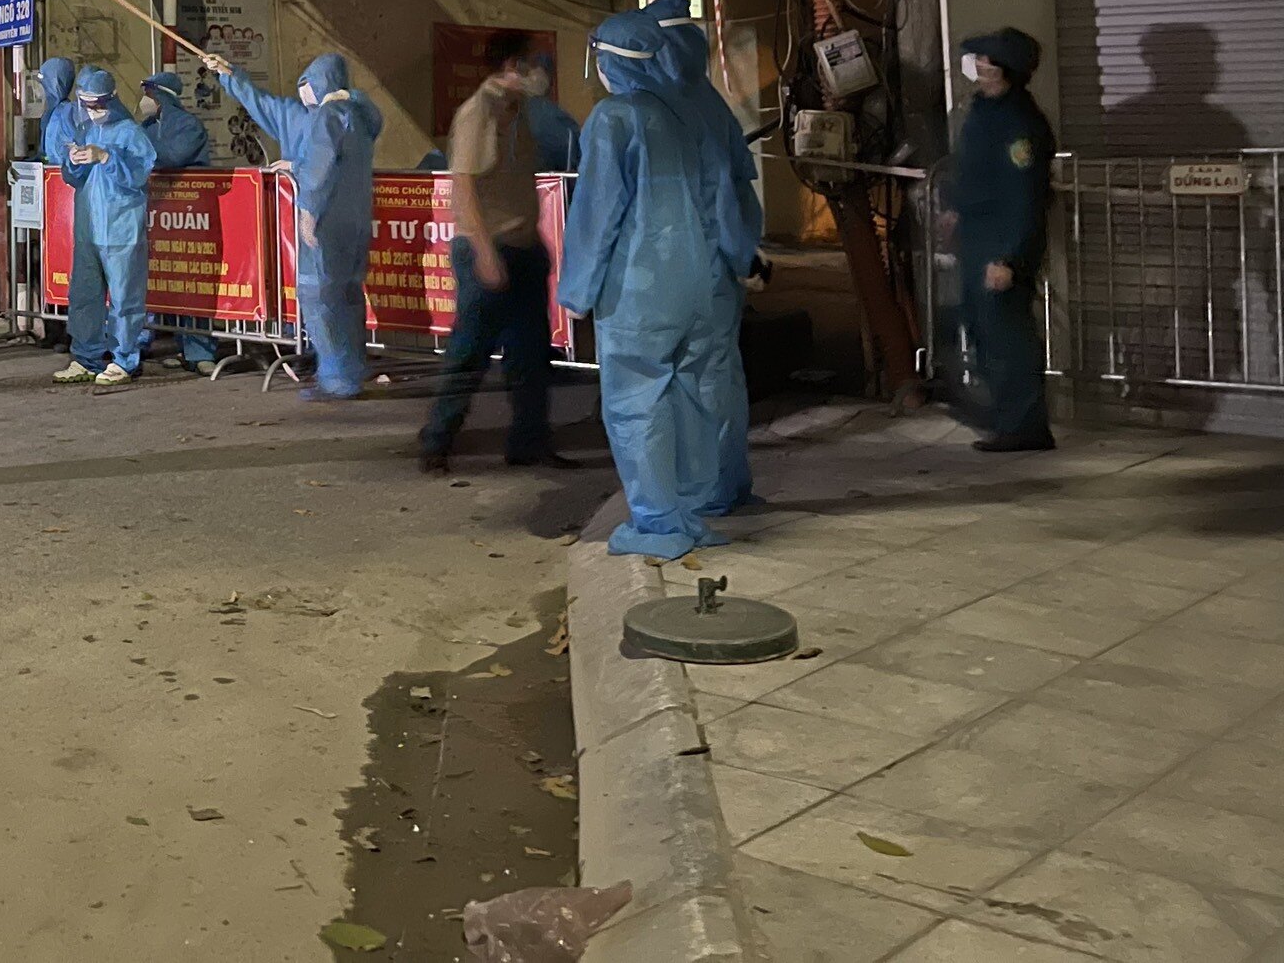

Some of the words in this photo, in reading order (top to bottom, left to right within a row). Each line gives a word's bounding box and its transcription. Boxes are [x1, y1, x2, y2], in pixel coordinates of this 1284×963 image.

[16, 0, 30, 21] 328
[191, 181, 215, 189] COVID
[160, 205, 210, 231] QUẢN
[387, 219, 418, 243] TỰ
